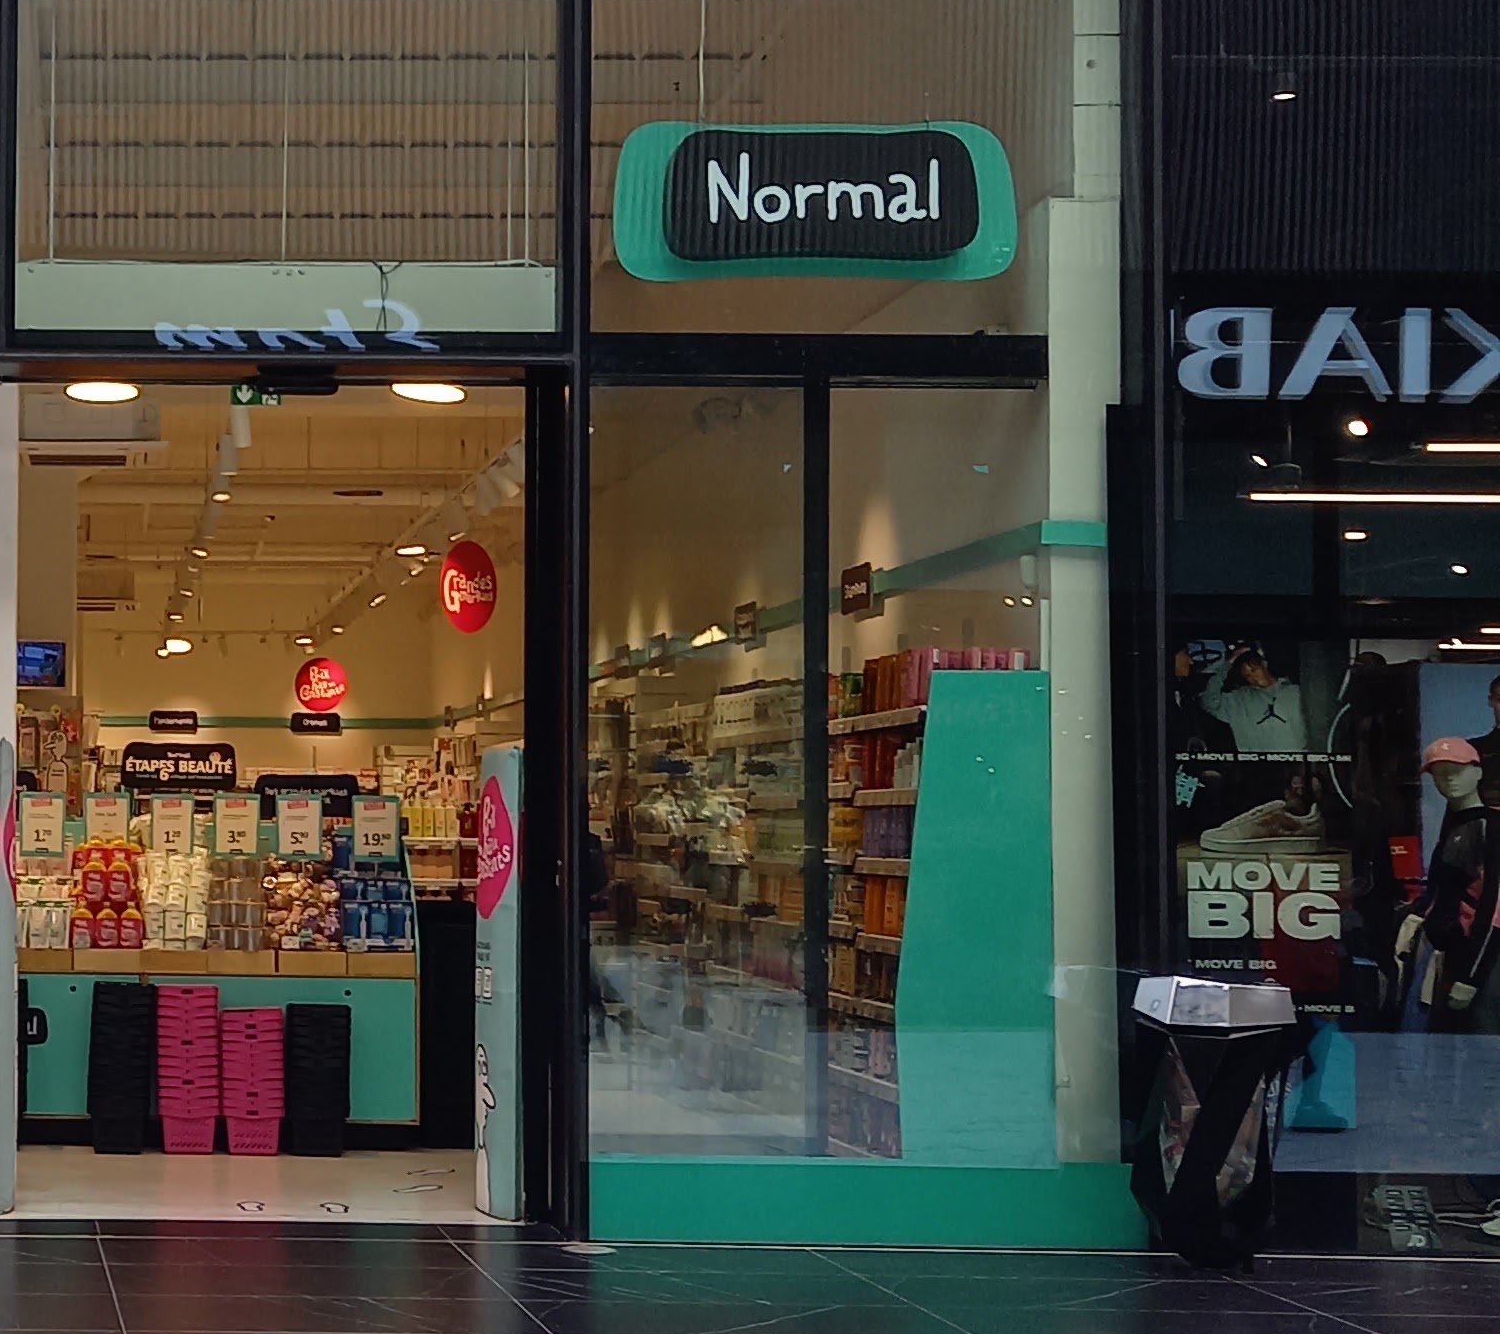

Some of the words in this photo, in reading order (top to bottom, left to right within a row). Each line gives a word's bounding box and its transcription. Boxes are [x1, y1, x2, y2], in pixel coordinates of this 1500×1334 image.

[706, 151, 941, 224] Normal
[178, 758, 233, 774] BEAUTÉ
[1186, 861, 1342, 891] MOVE
[1187, 891, 1342, 941] BIG
[1195, 958, 1244, 969] MOVE
[1248, 959, 1278, 970] BIG
